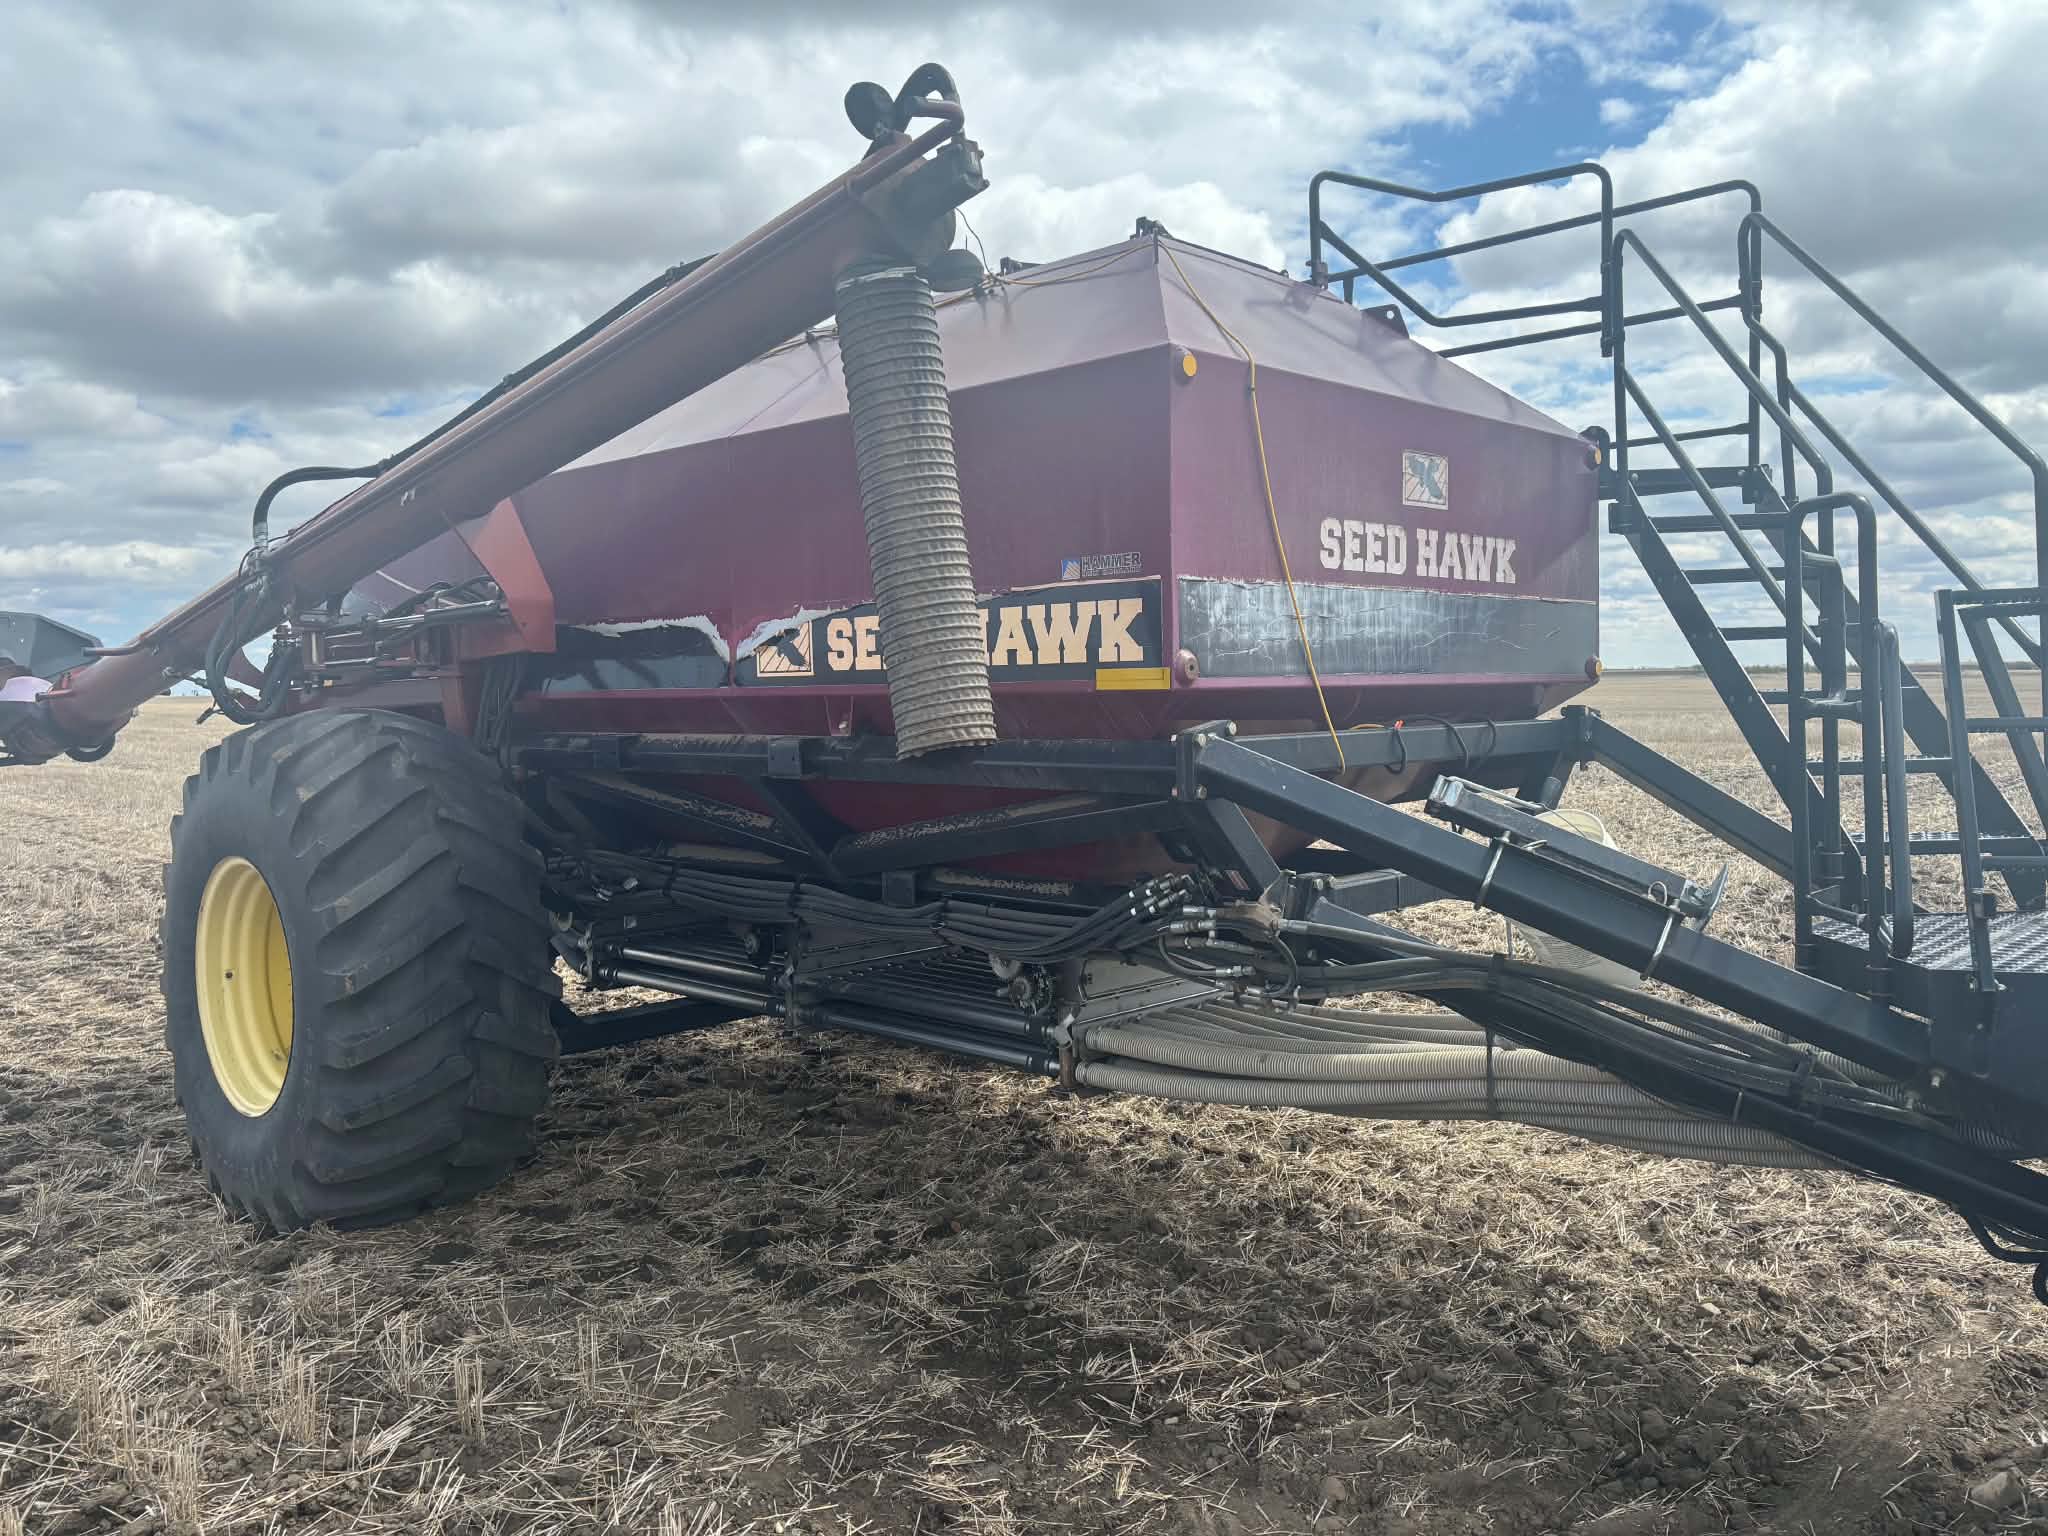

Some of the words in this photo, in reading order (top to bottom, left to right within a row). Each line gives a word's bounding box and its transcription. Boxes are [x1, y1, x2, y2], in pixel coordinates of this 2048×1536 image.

[1081, 551, 1141, 570] HAMMER
[1320, 517, 1407, 575] SEED
[1416, 528, 1516, 584] HAWK
[827, 616, 887, 671] SE
